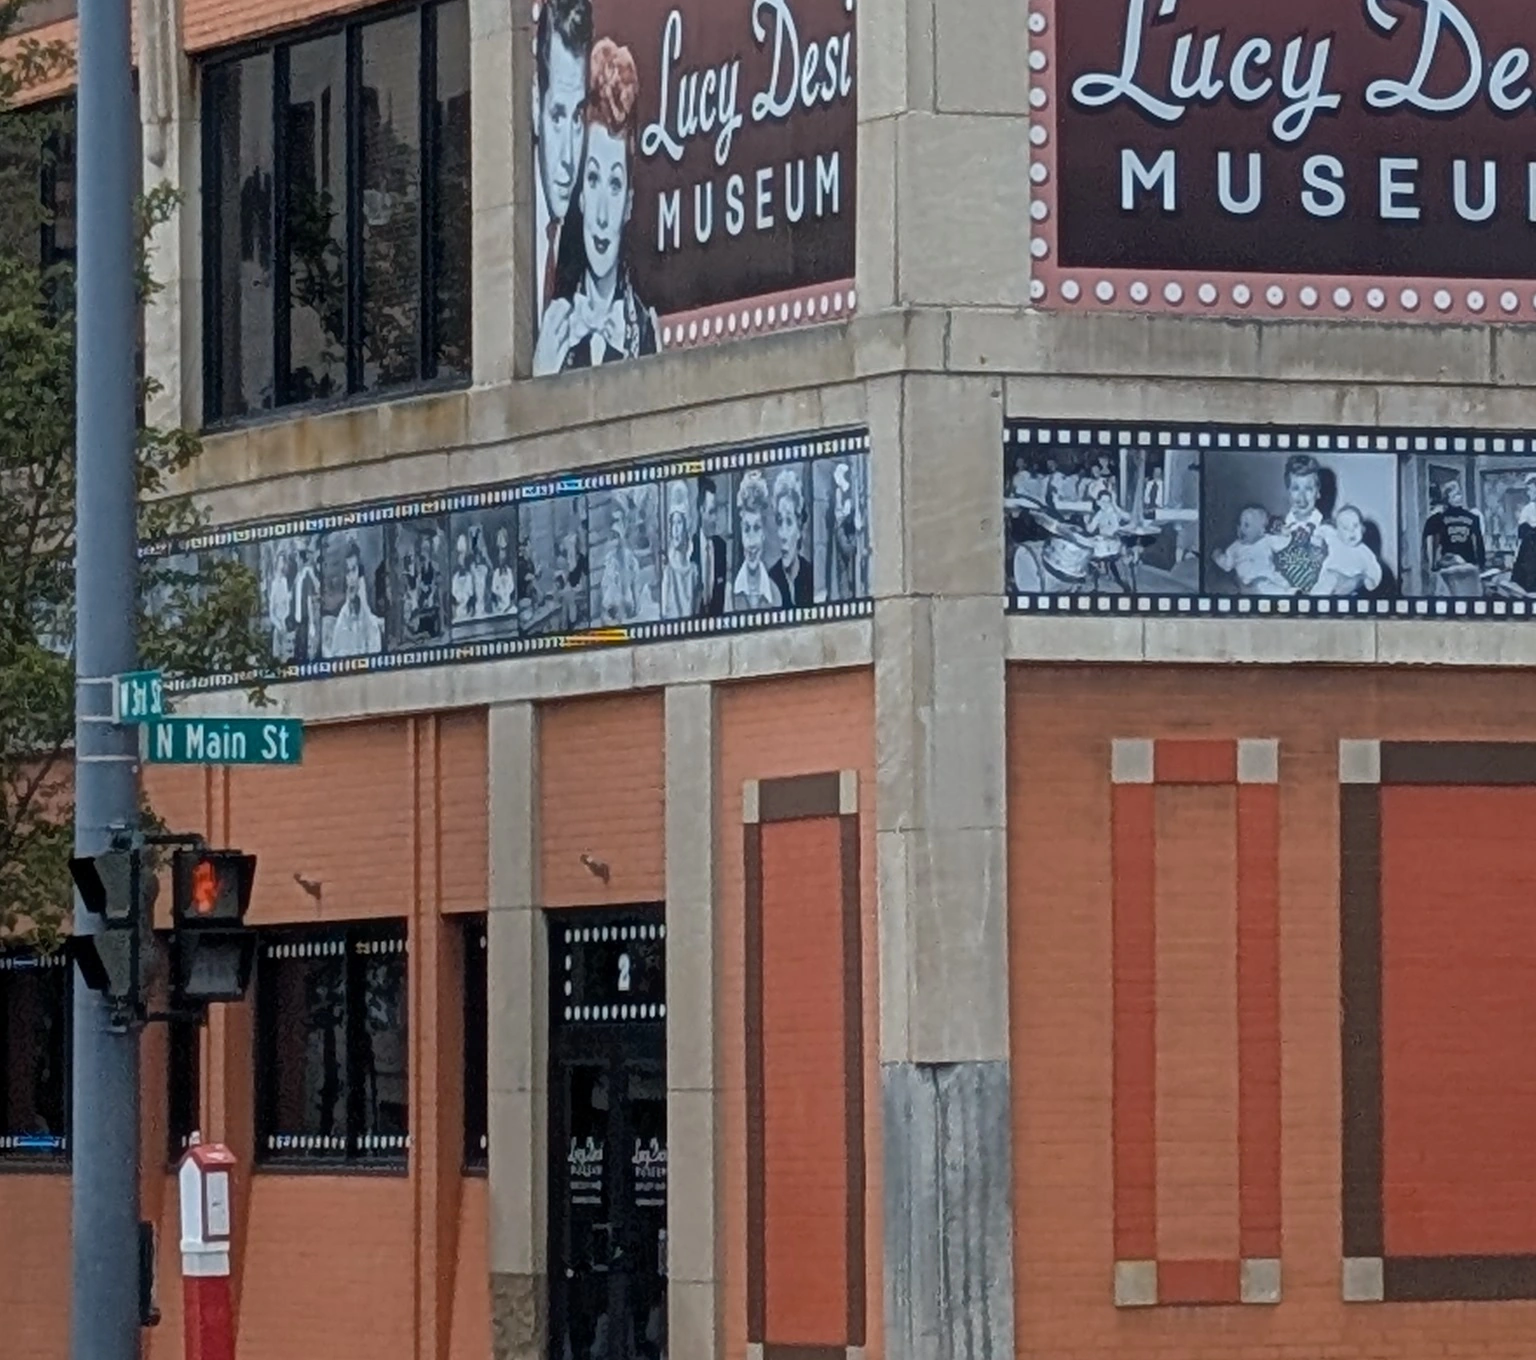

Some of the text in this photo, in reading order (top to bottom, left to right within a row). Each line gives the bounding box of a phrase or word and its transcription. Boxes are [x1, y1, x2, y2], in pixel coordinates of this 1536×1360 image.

[641, 10, 743, 165] Lucy
[657, 151, 840, 252] MUSEUM
[157, 723, 289, 760] N Main St
[617, 952, 631, 991] 2
